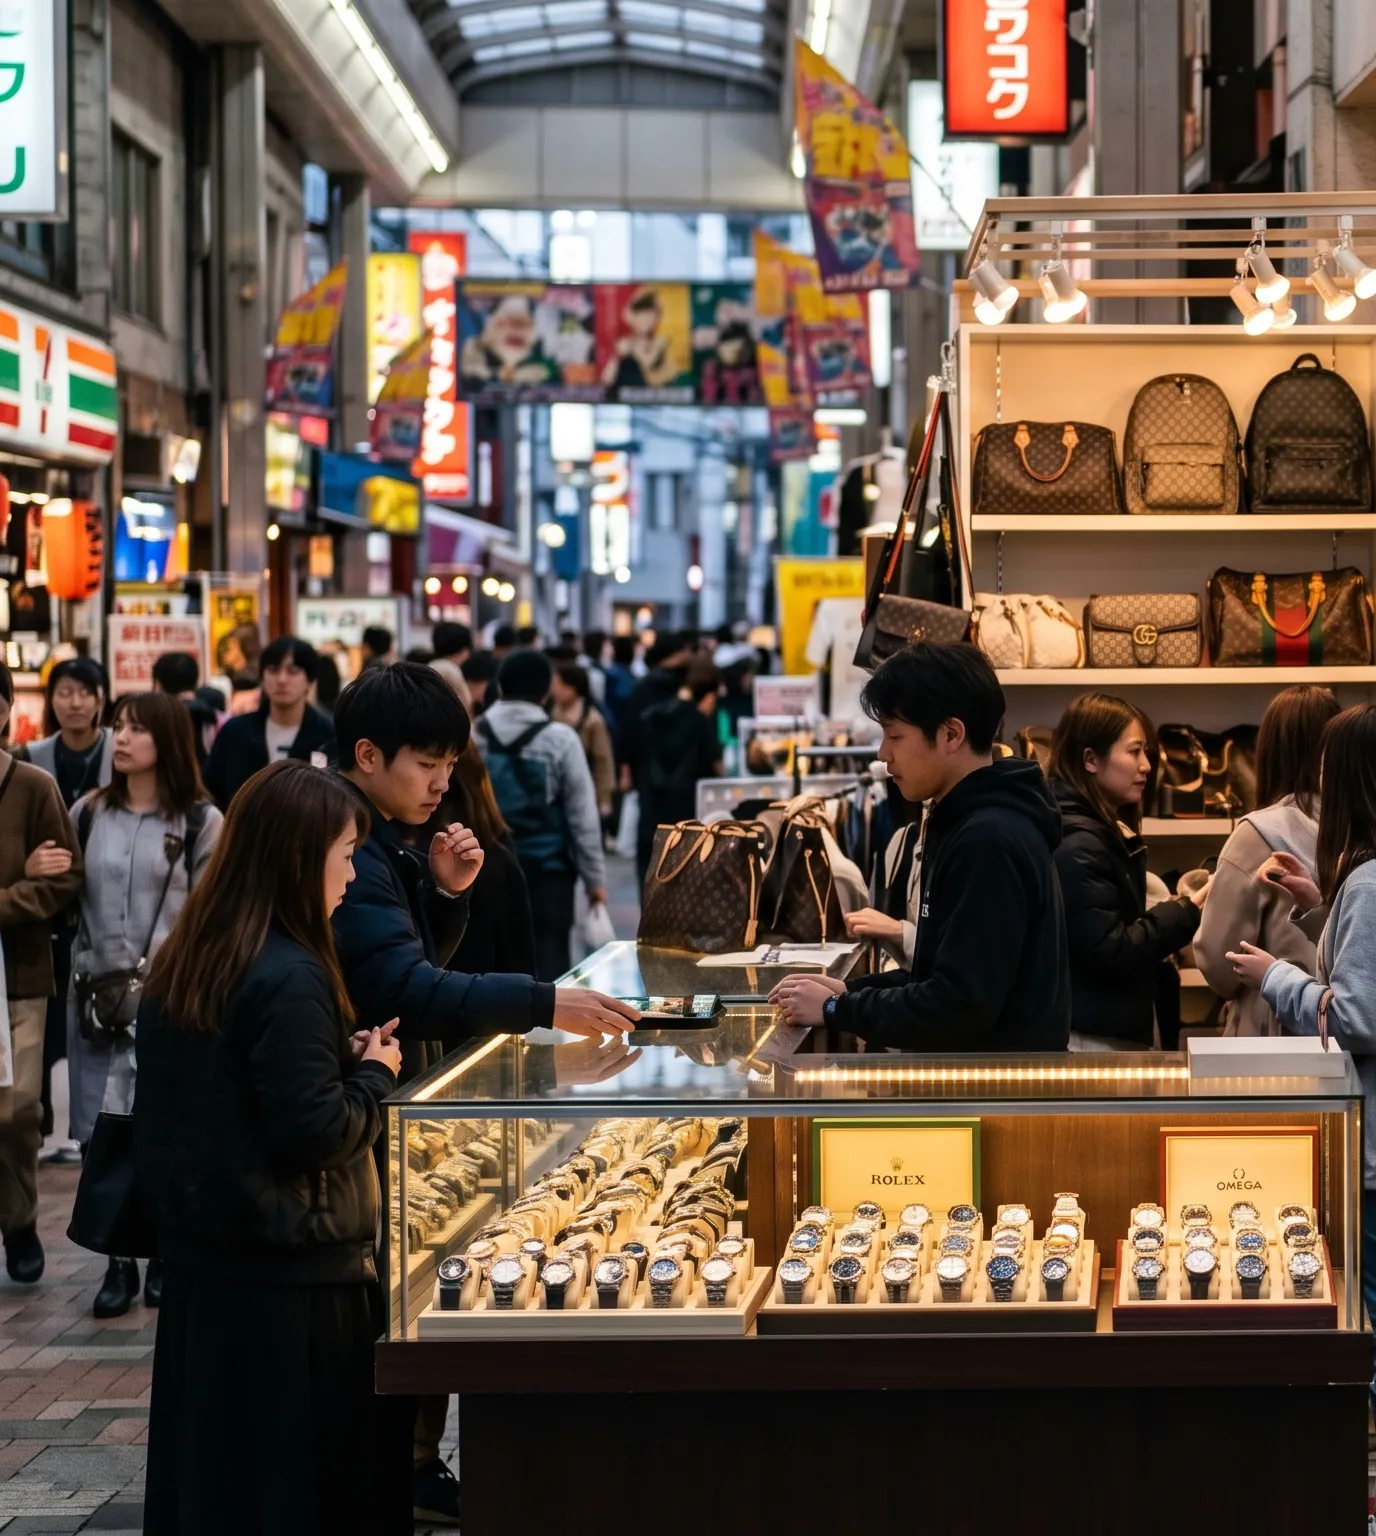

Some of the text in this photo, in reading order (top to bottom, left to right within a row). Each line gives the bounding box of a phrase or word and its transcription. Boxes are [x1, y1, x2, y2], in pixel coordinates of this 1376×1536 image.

[984, 0, 1029, 120] ワコク
[871, 1174, 925, 1186] ROLEX
[1216, 1180, 1263, 1191] OMEGA
